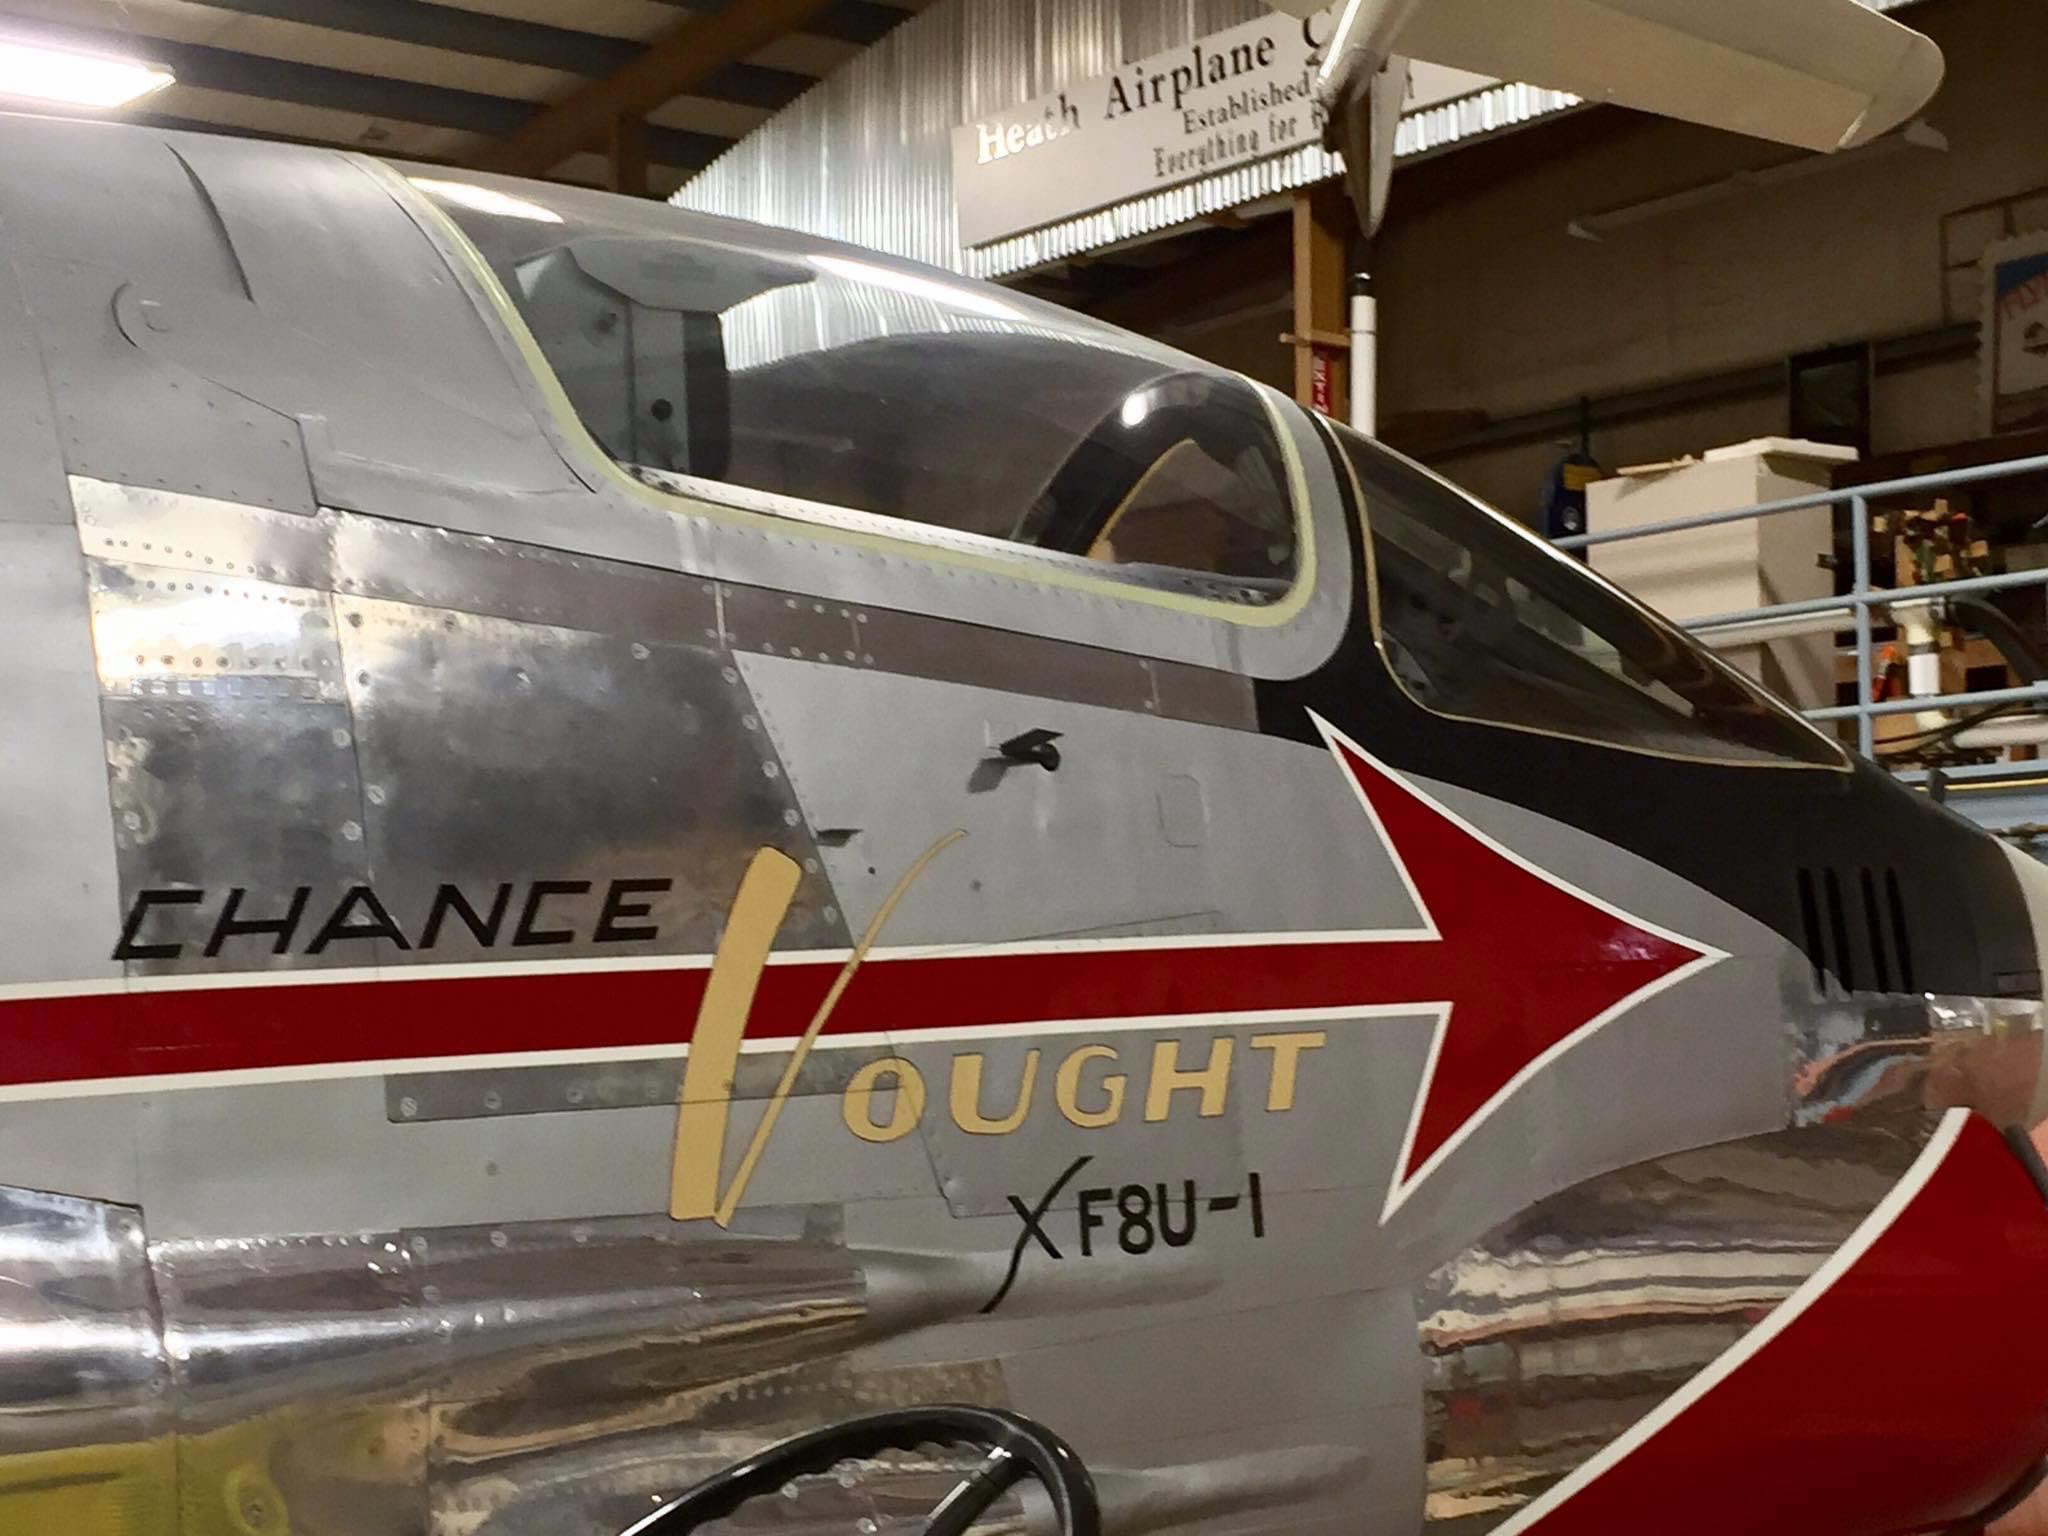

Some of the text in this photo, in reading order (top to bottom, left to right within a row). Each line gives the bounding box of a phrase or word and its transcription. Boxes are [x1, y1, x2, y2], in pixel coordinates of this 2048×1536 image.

[975, 92, 1080, 164] Heath
[1104, 35, 1275, 119] Airplane
[1182, 69, 1312, 134] Established
[1153, 128, 1260, 177] Everything
[1268, 112, 1297, 143] for
[113, 878, 673, 961] CHANCE
